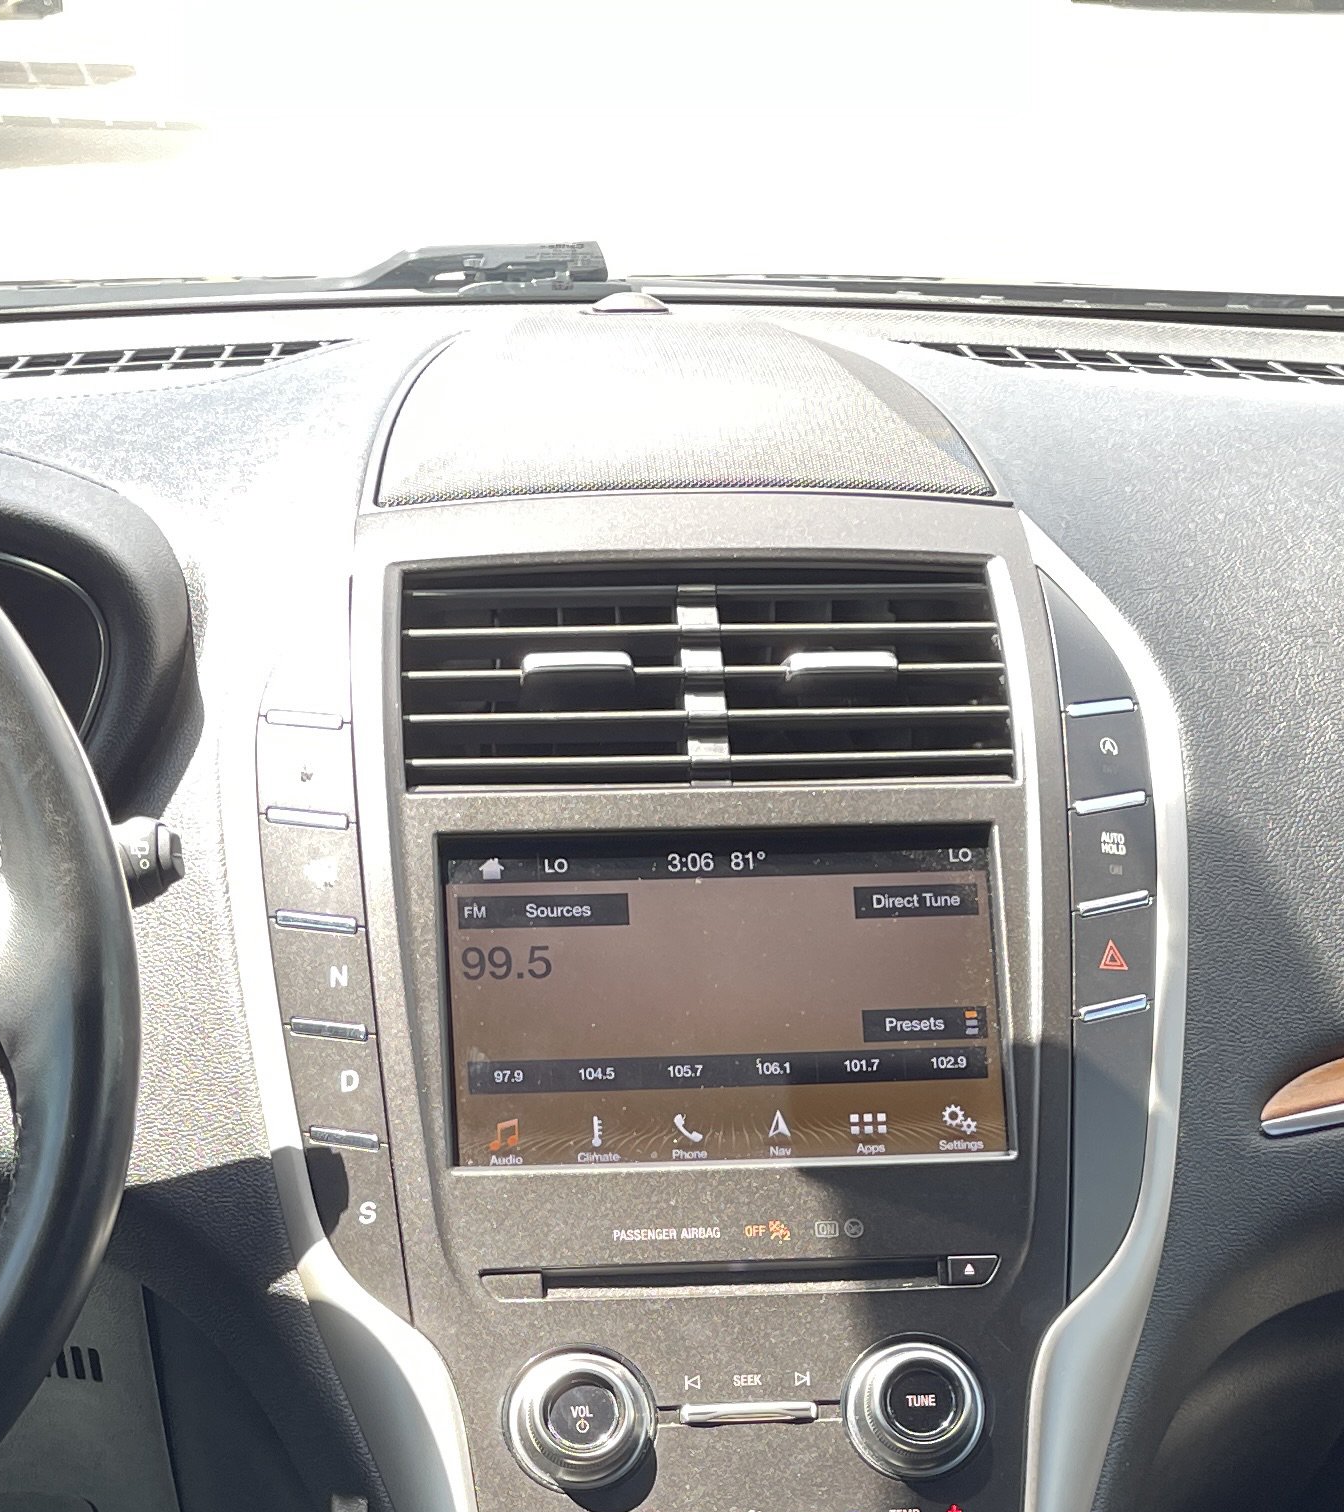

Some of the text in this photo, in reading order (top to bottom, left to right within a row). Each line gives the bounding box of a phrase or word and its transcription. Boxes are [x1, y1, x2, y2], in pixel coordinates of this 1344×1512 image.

[1101, 831, 1125, 844] AUTO
[949, 848, 972, 863] LO
[1101, 843, 1126, 855] HOLD
[544, 858, 568, 873] LO
[667, 851, 766, 872] 3:06 81°
[872, 892, 961, 908] Direct Tune
[464, 903, 592, 919] FM Sources
[461, 946, 552, 980] 99.5
[329, 965, 348, 988] N
[885, 1017, 945, 1032] Presets
[494, 1056, 967, 1083] 97.9 104.5 105.7 106.1 101.7 102.9
[340, 1069, 360, 1093] D
[490, 1139, 984, 1166] Audio Climate Phone Nav Apps Settings
[358, 1201, 377, 1225] S
[613, 1226, 721, 1241] PASSENGER AIRBAG
[744, 1225, 766, 1237] OFF
[819, 1223, 835, 1235] ON
[733, 1374, 763, 1388] SEEK
[905, 1394, 936, 1408] TUNE
[570, 1405, 593, 1419] VOL
